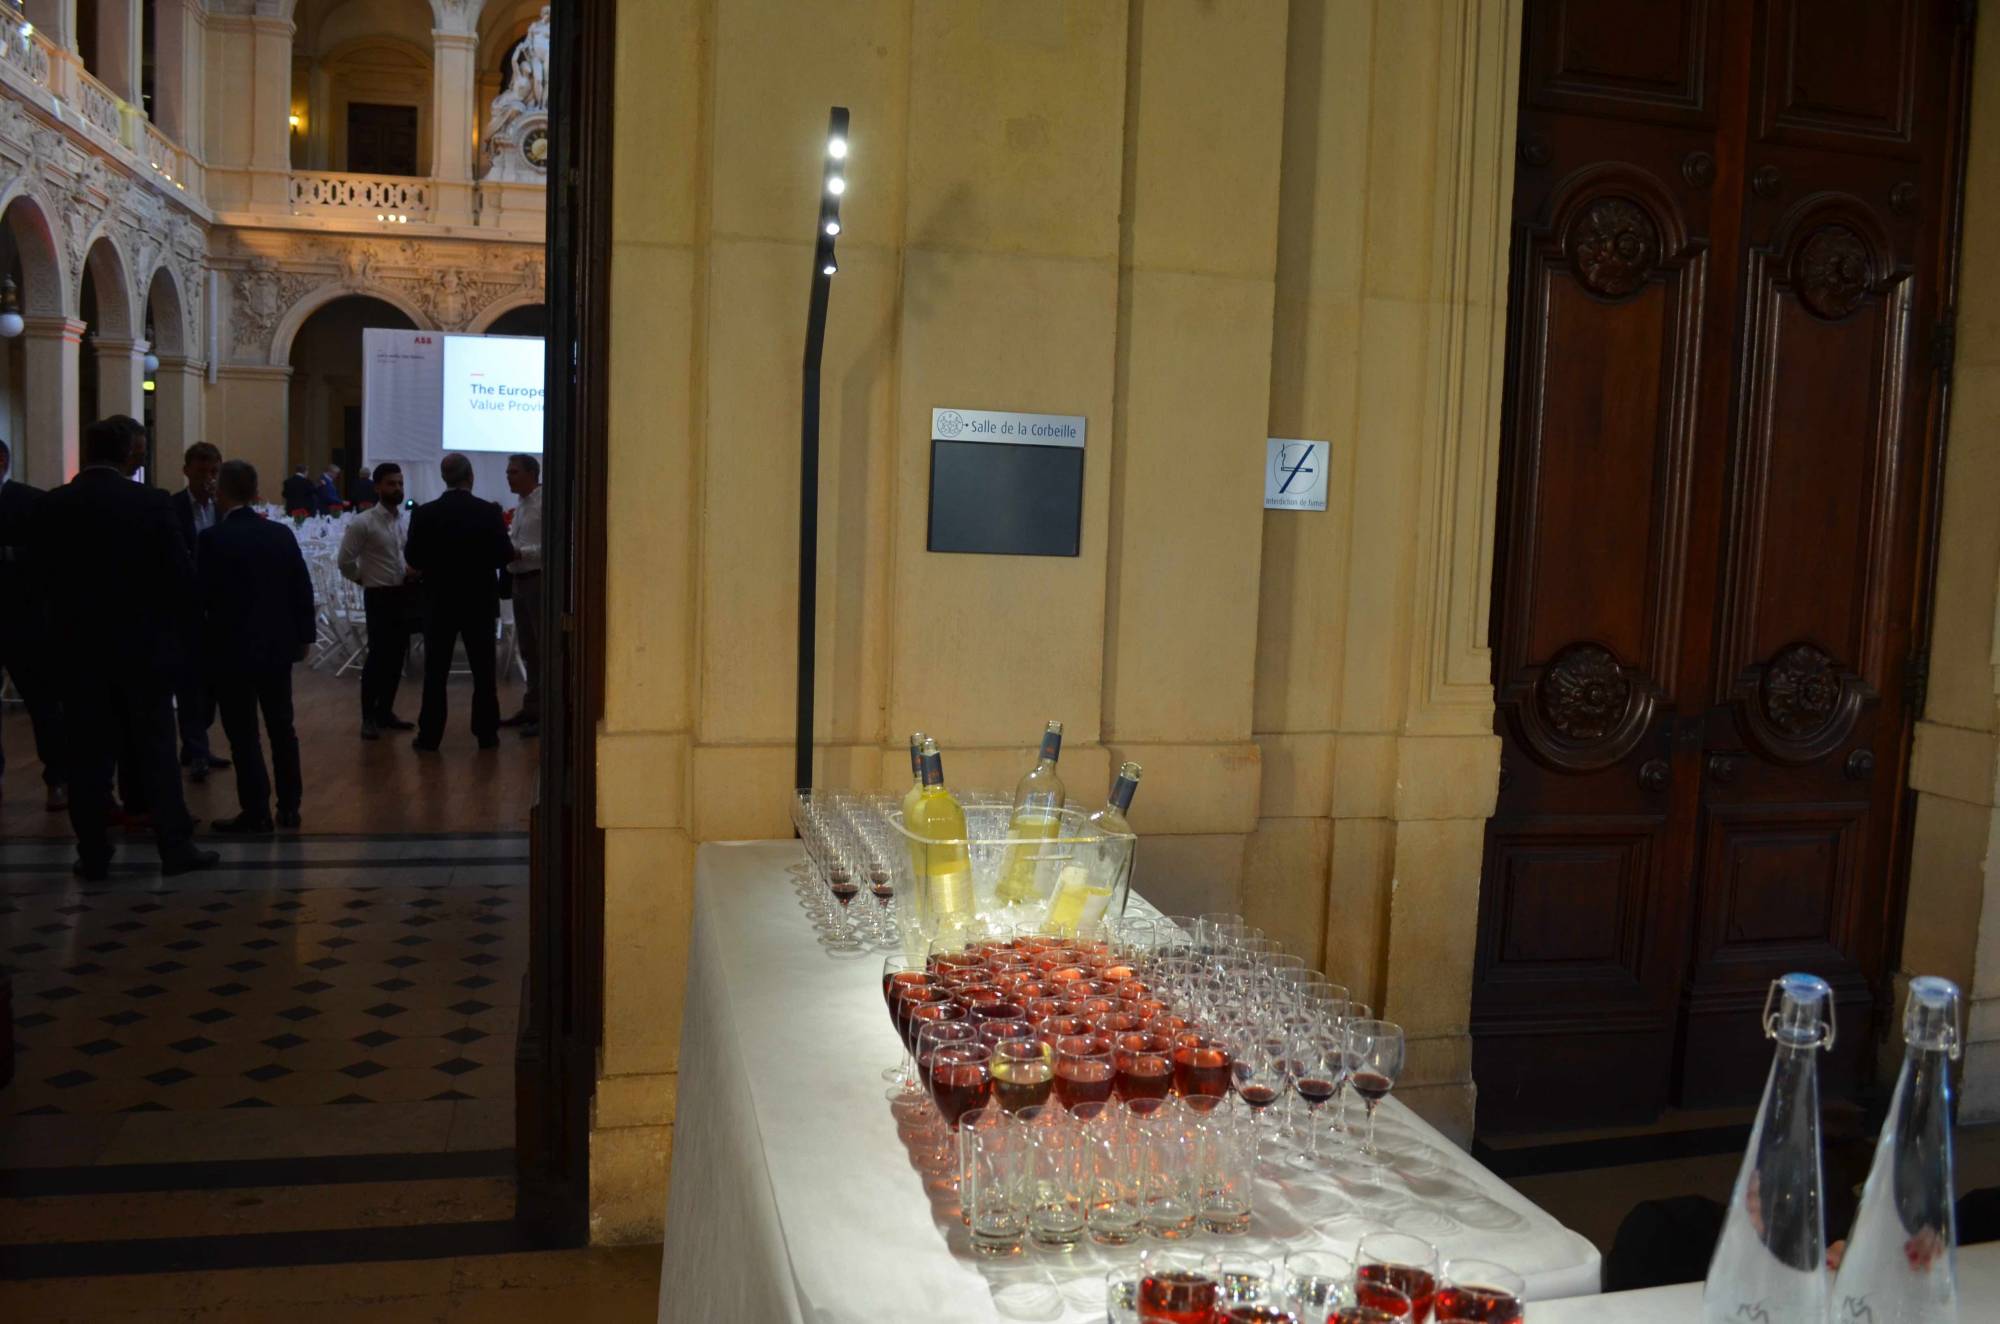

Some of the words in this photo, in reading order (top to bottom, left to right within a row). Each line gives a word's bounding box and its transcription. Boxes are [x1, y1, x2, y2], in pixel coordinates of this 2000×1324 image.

[414, 337, 432, 345] ABB
[470, 384, 495, 394] The
[498, 385, 544, 399] Europe
[470, 400, 505, 410] Value
[508, 401, 544, 412] Provi
[971, 420, 997, 434] Salle
[1001, 422, 1014, 435] de
[1018, 421, 1027, 436] la
[1031, 423, 1077, 438] Corbeille
